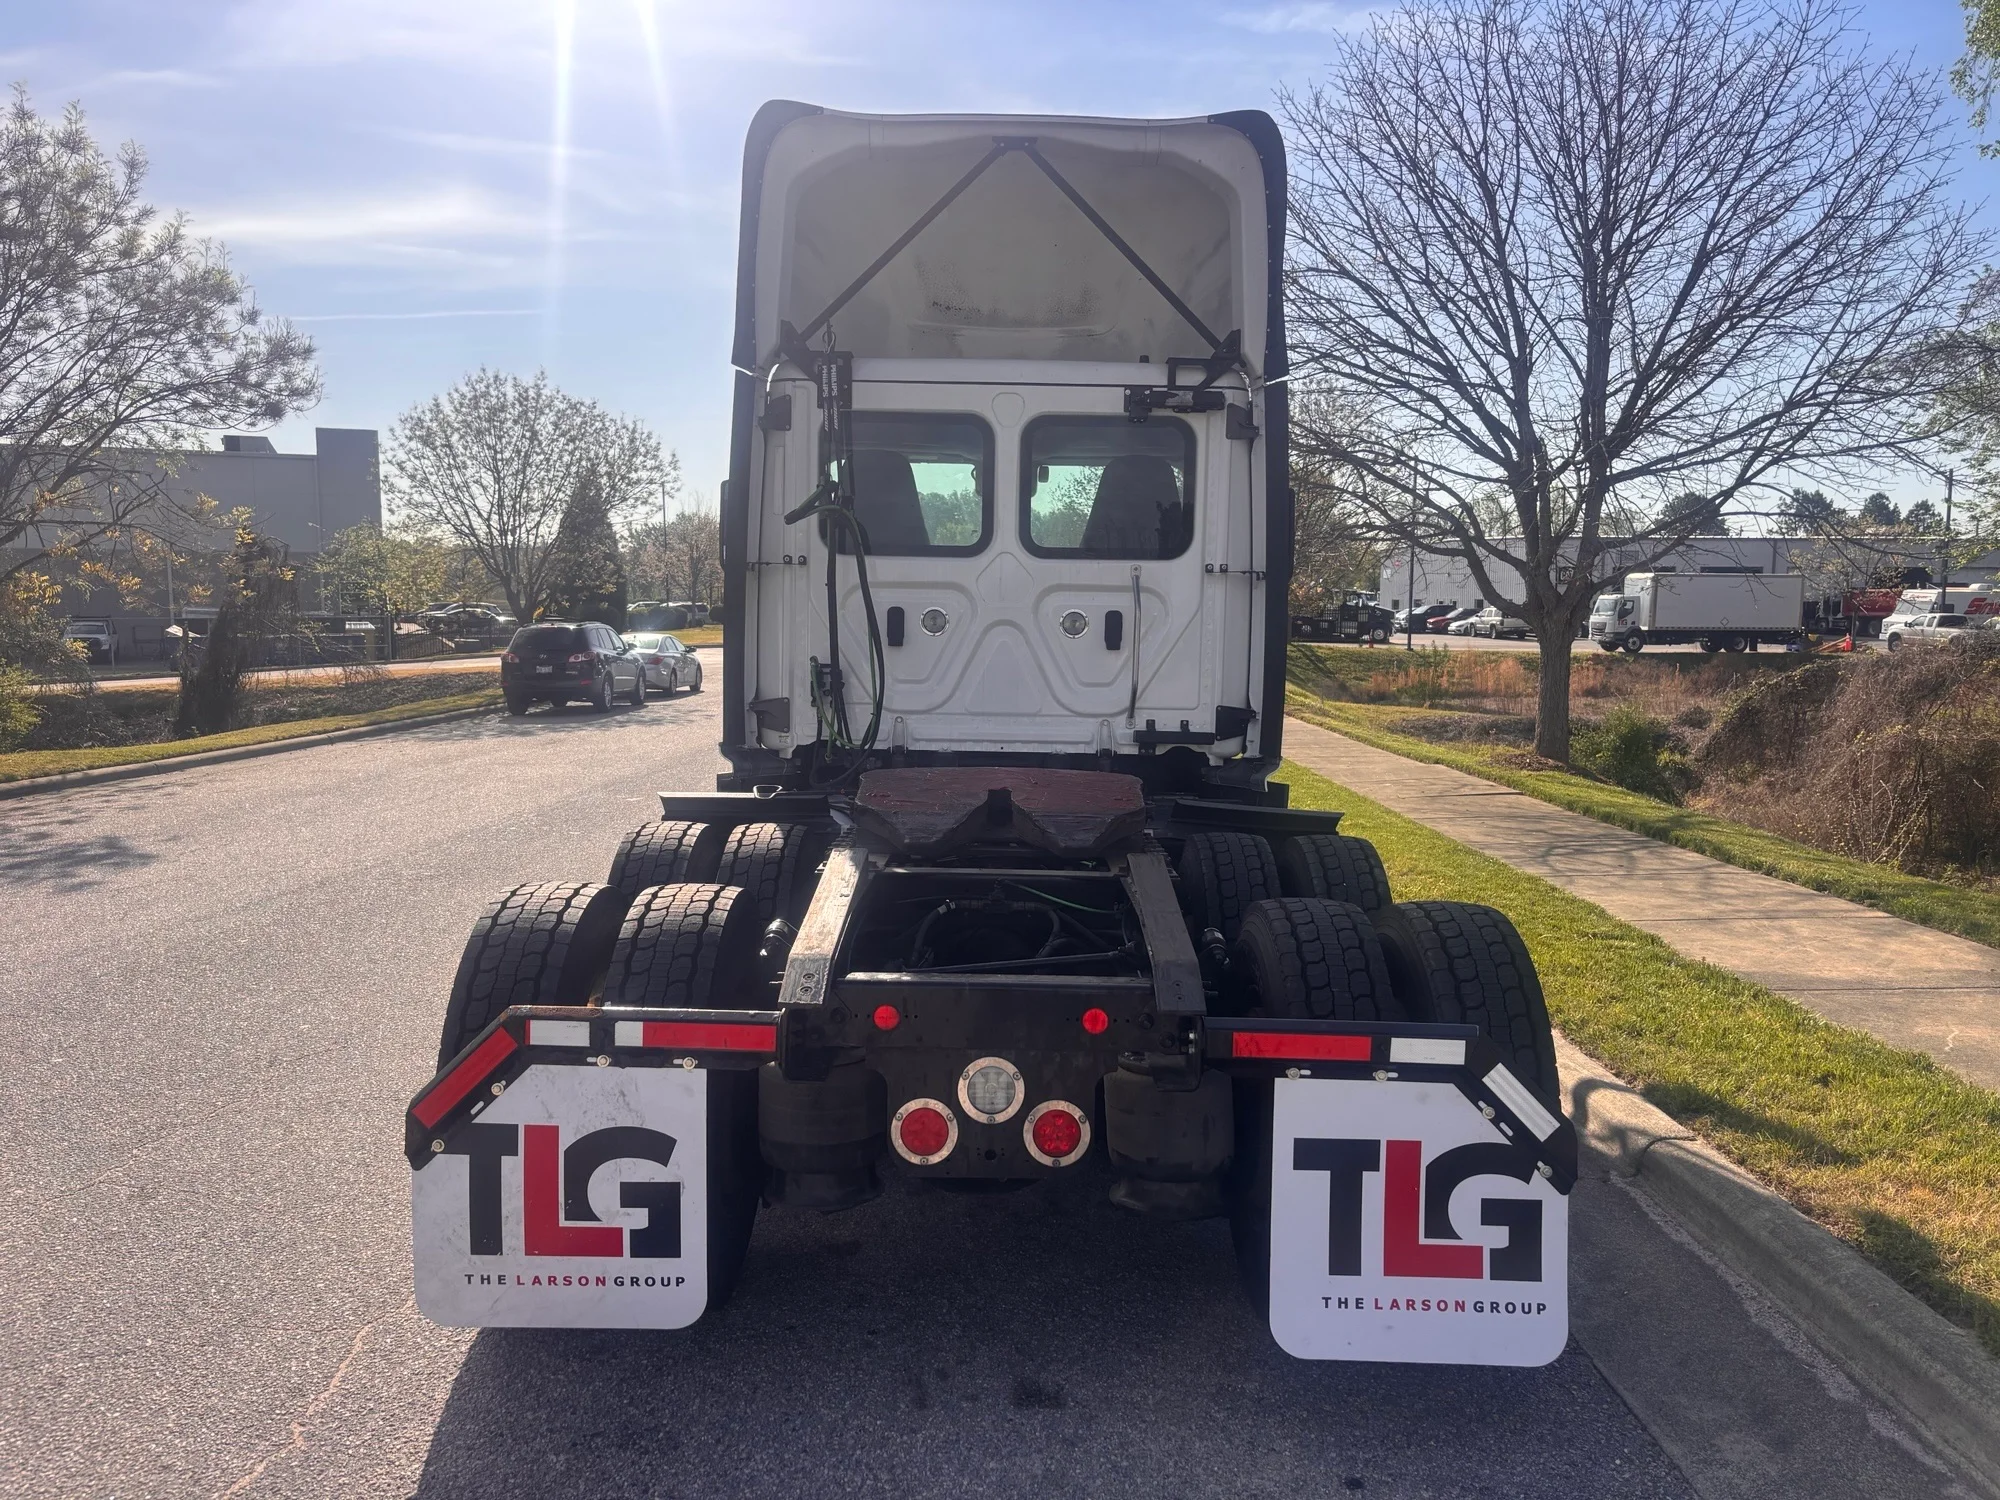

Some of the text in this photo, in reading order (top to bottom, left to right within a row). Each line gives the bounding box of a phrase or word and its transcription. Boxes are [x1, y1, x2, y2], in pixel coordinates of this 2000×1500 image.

[440, 1123, 682, 1258] TLG
[1293, 1138, 1543, 1282] TLG
[464, 1274, 686, 1288] THE LARSON GROUP
[1321, 1296, 1547, 1315] THE LARSON GROUP
